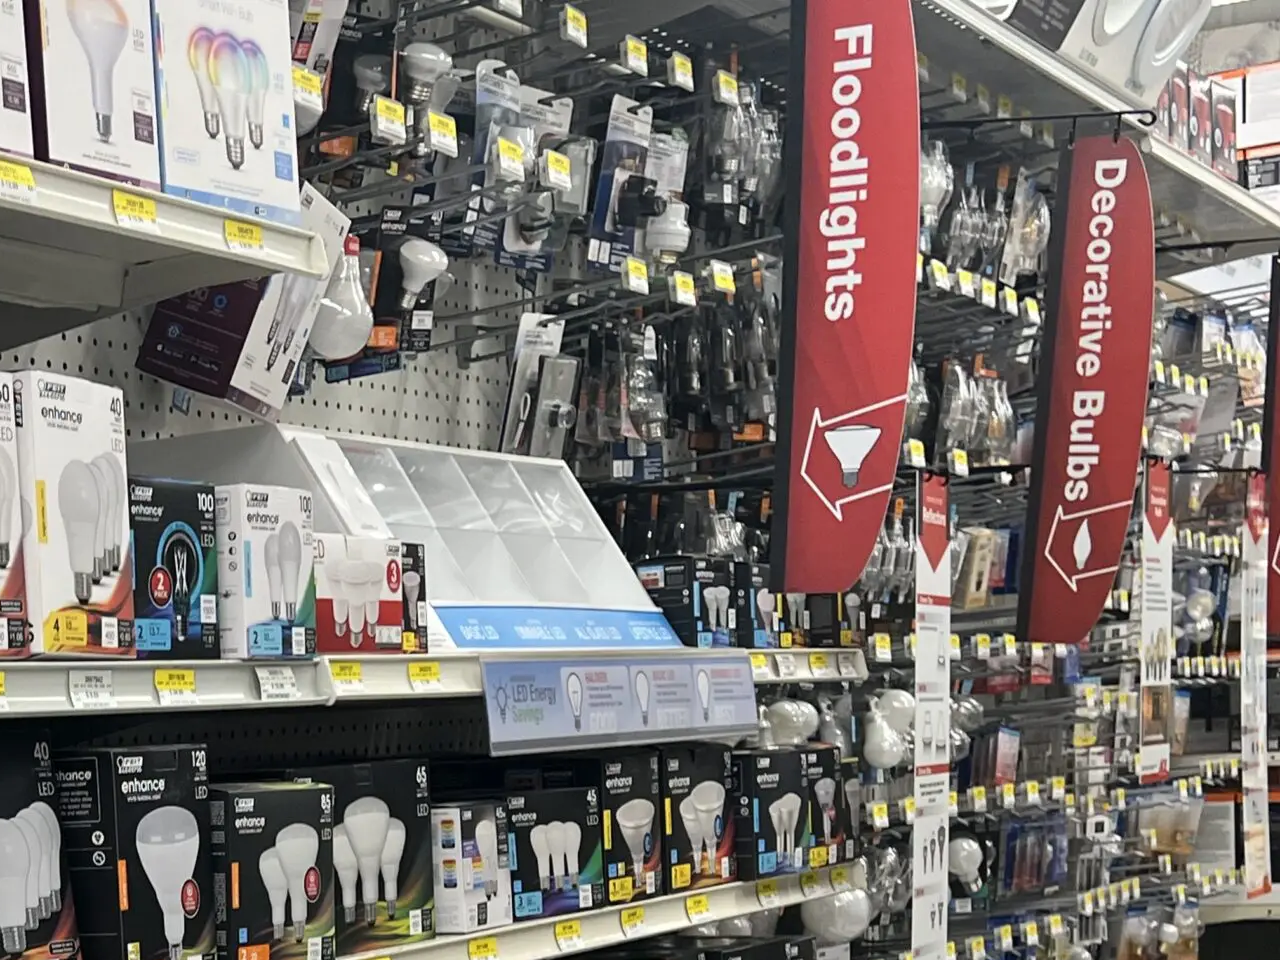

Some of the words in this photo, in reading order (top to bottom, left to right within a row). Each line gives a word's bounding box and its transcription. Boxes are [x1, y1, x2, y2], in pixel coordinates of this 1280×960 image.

[820, 24, 873, 321] Floodlights
[1075, 158, 1128, 378] Decorative
[1064, 390, 1105, 501] Bulbs
[197, 493, 214, 511] 100
[299, 496, 312, 512] 100
[247, 512, 279, 525] enhance
[201, 533, 215, 548] LED
[529, 684, 556, 704] Energy
[512, 707, 544, 725] Savings
[416, 766, 427, 783] 65
[121, 778, 165, 794] enhance
[417, 804, 429, 817] LED
[235, 816, 265, 828] enhance
